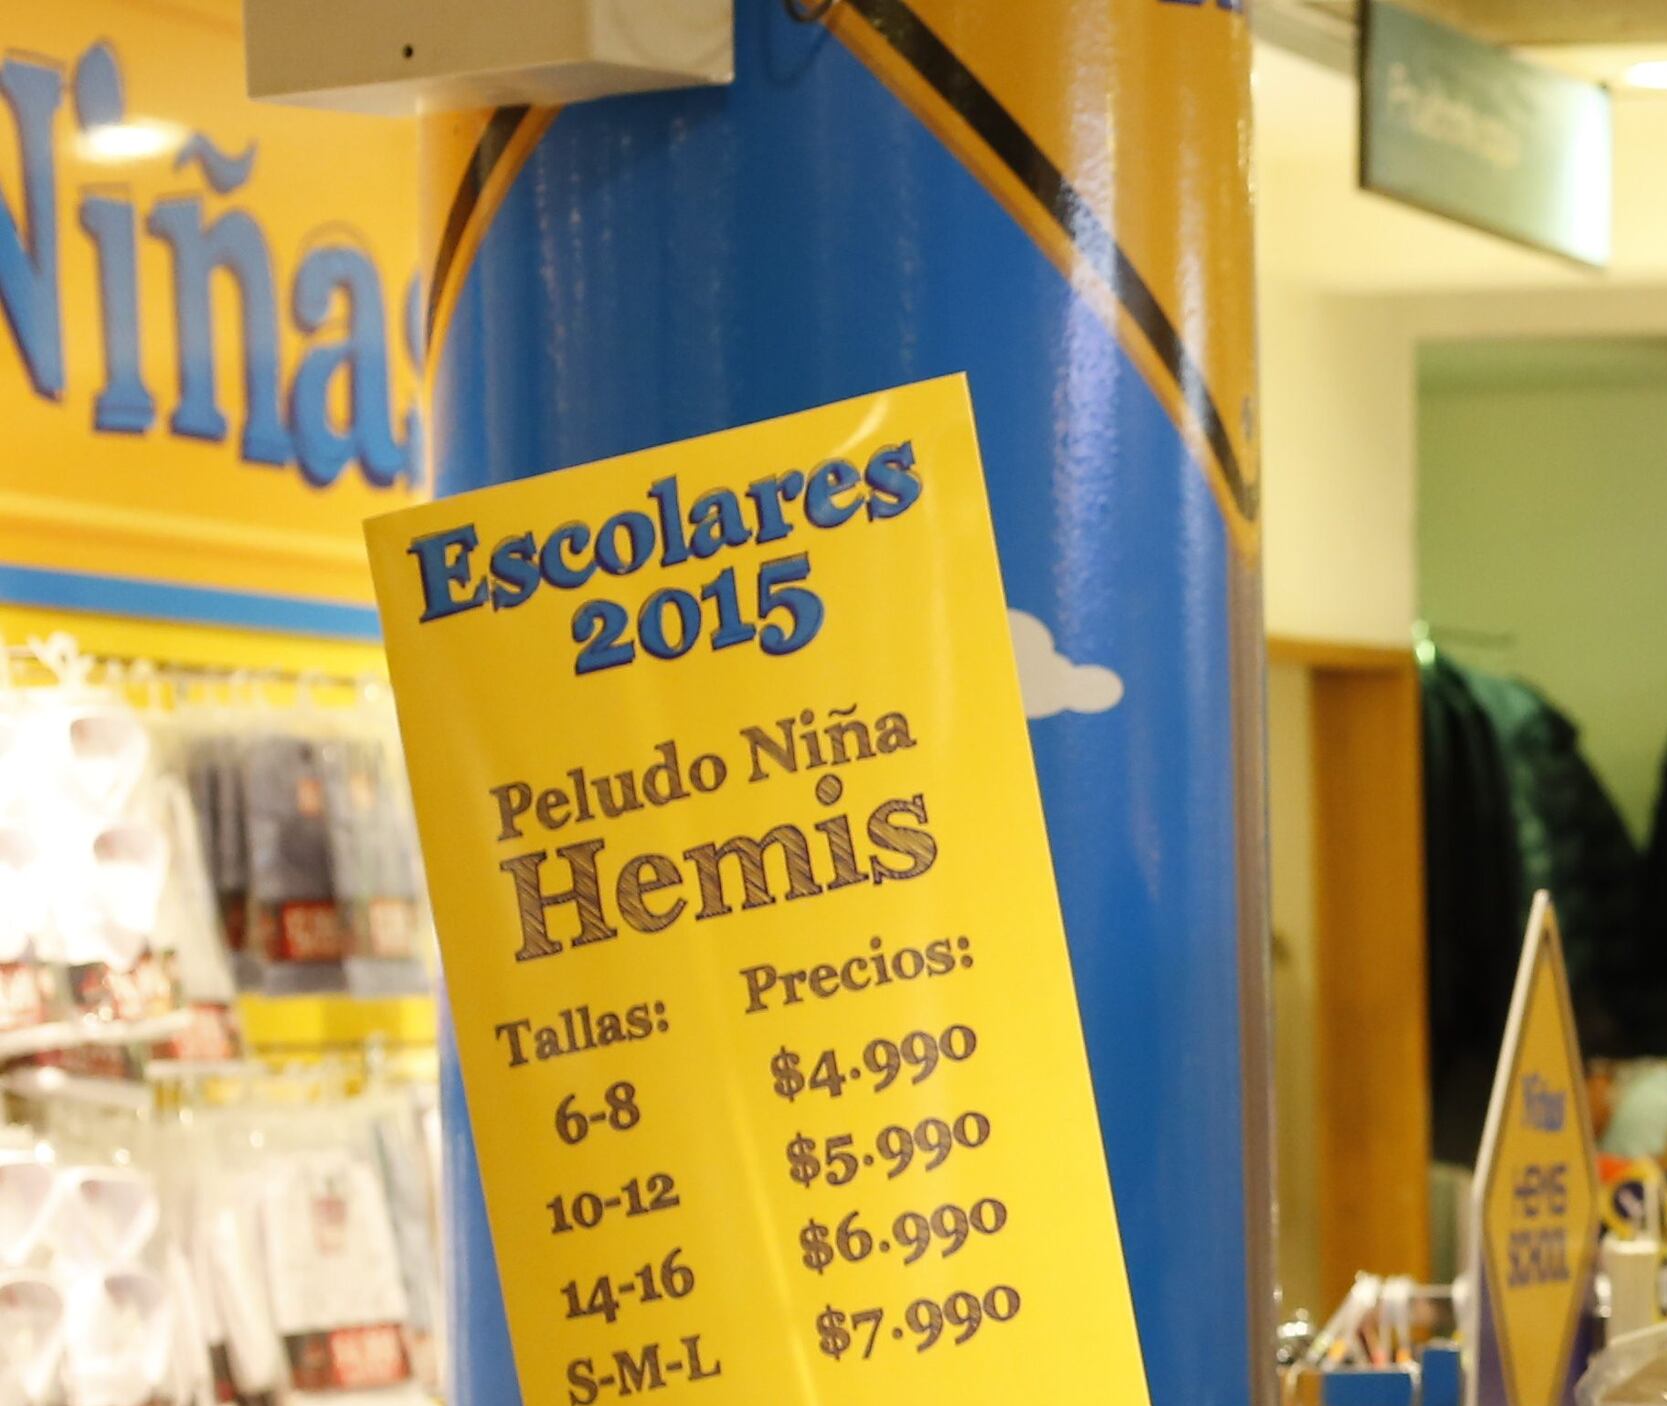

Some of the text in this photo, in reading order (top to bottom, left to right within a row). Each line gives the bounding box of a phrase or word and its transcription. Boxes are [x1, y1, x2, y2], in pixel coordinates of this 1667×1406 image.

[0, 40, 424, 488] Niña
[407, 440, 923, 624] Escolares
[571, 552, 824, 676] 2015
[489, 704, 916, 841] Peludo Niña
[500, 774, 938, 962] Hemis
[740, 935, 974, 1014] Precios:
[495, 1000, 670, 1068] Tallas:
[770, 1023, 978, 1102] $4.990
[553, 1080, 641, 1145] 6-8
[785, 1110, 991, 1188] $5.990
[546, 1172, 680, 1235] 10-12
[800, 1197, 1008, 1275] $6.990
[561, 1248, 695, 1324] 14-16
[815, 1284, 1021, 1361] $7.990
